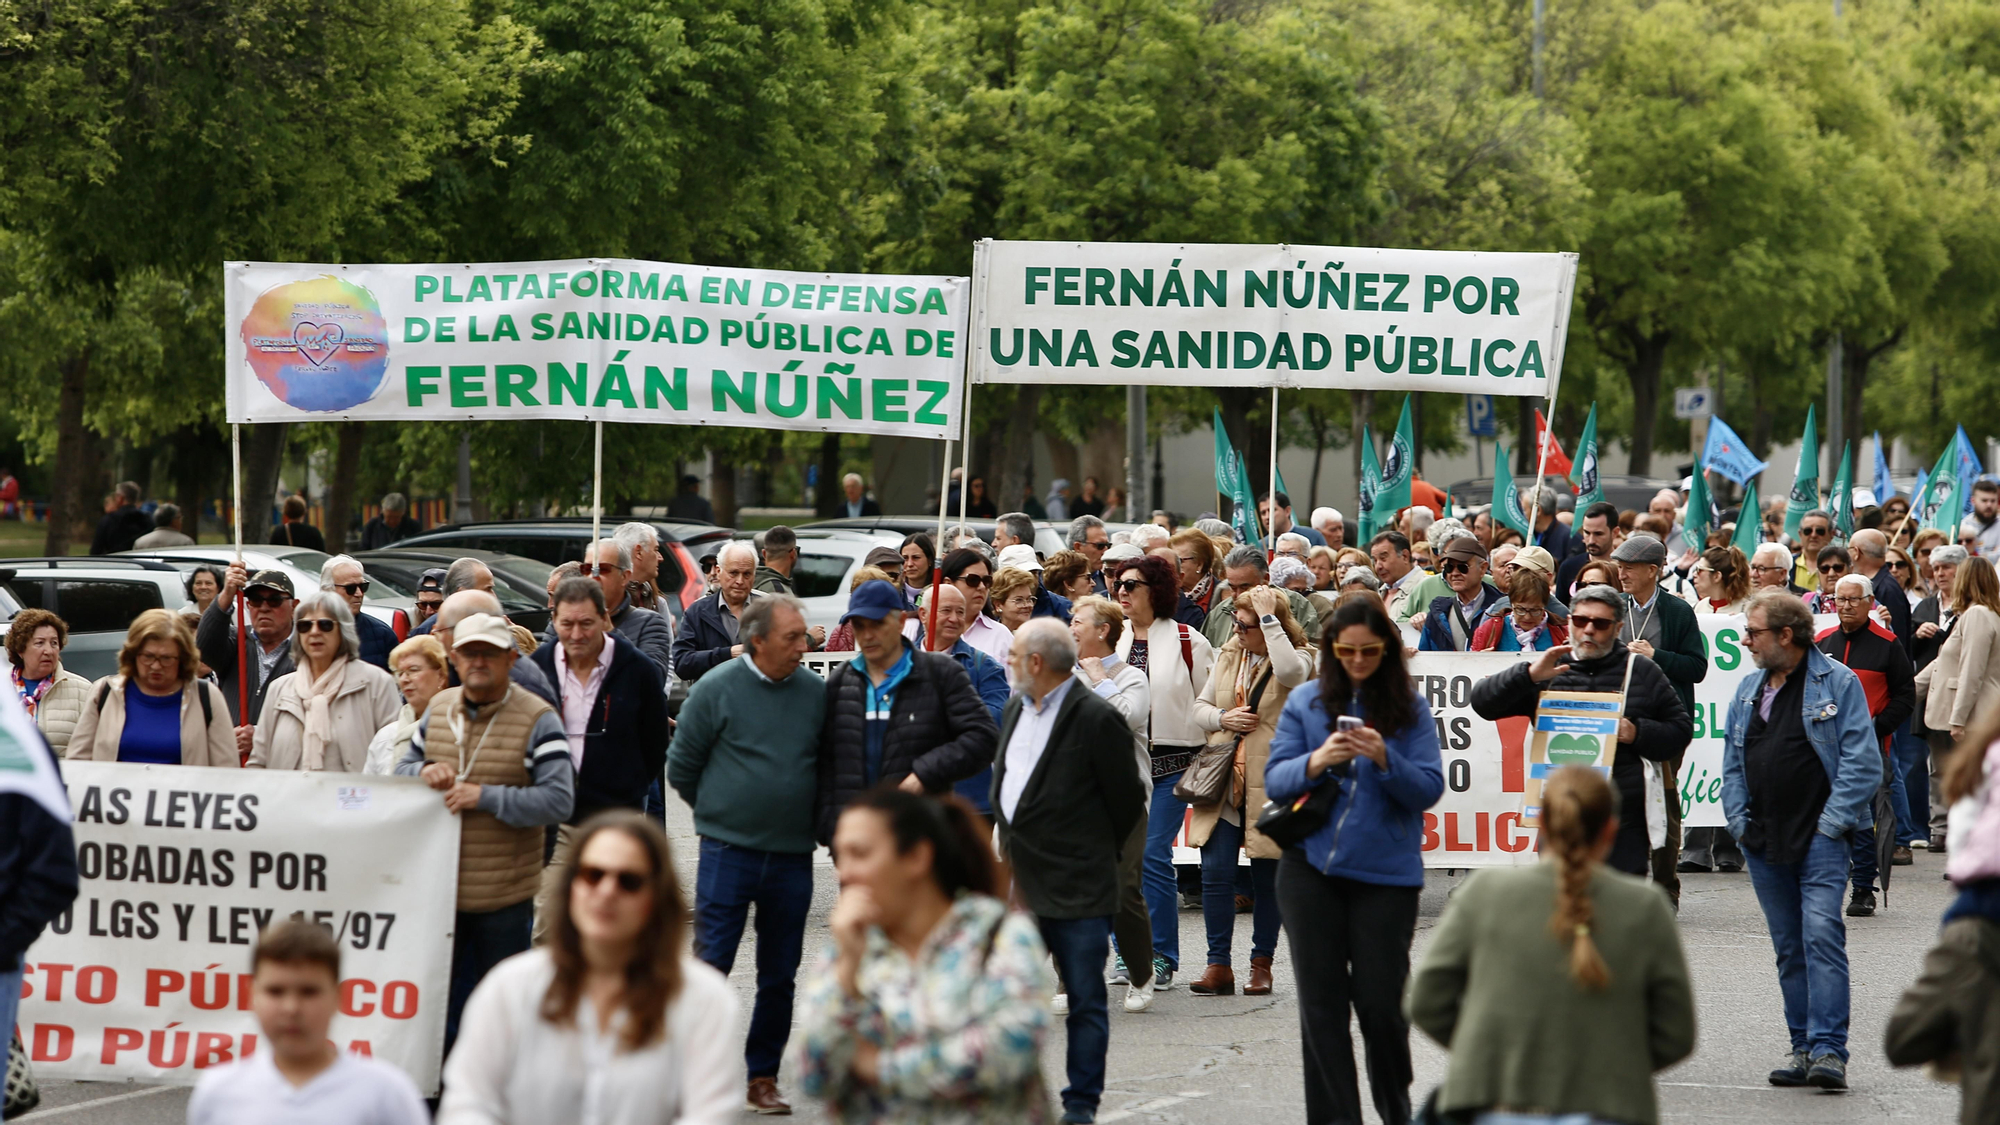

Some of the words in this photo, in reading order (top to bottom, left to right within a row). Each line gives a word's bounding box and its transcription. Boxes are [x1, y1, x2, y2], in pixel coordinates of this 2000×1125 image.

[415, 270, 689, 303] PLATAFORMA
[700, 278, 751, 306] EN
[762, 283, 948, 316] DEFENSA
[1025, 258, 1227, 308] FERNÁN
[1244, 261, 1410, 312] NÚÑEZ
[1423, 274, 1519, 316] POR
[404, 317, 456, 343] DE
[468, 316, 521, 342] LA
[531, 312, 709, 345] SANIDAD
[721, 314, 894, 356] PÚBLICA
[905, 328, 955, 359] DE
[990, 327, 1099, 368] UNA
[1110, 329, 1332, 371] SANIDAD
[1345, 325, 1545, 379] PÚBLICA
[405, 349, 688, 411] FERNÁN
[711, 360, 950, 426] NÚÑEZ
[72, 785, 132, 826] AS
[144, 787, 259, 832] LEYES
[250, 851, 327, 892] POR
[89, 898, 160, 940] LGS
[173, 903, 195, 942] Y
[208, 905, 274, 945] LEY
